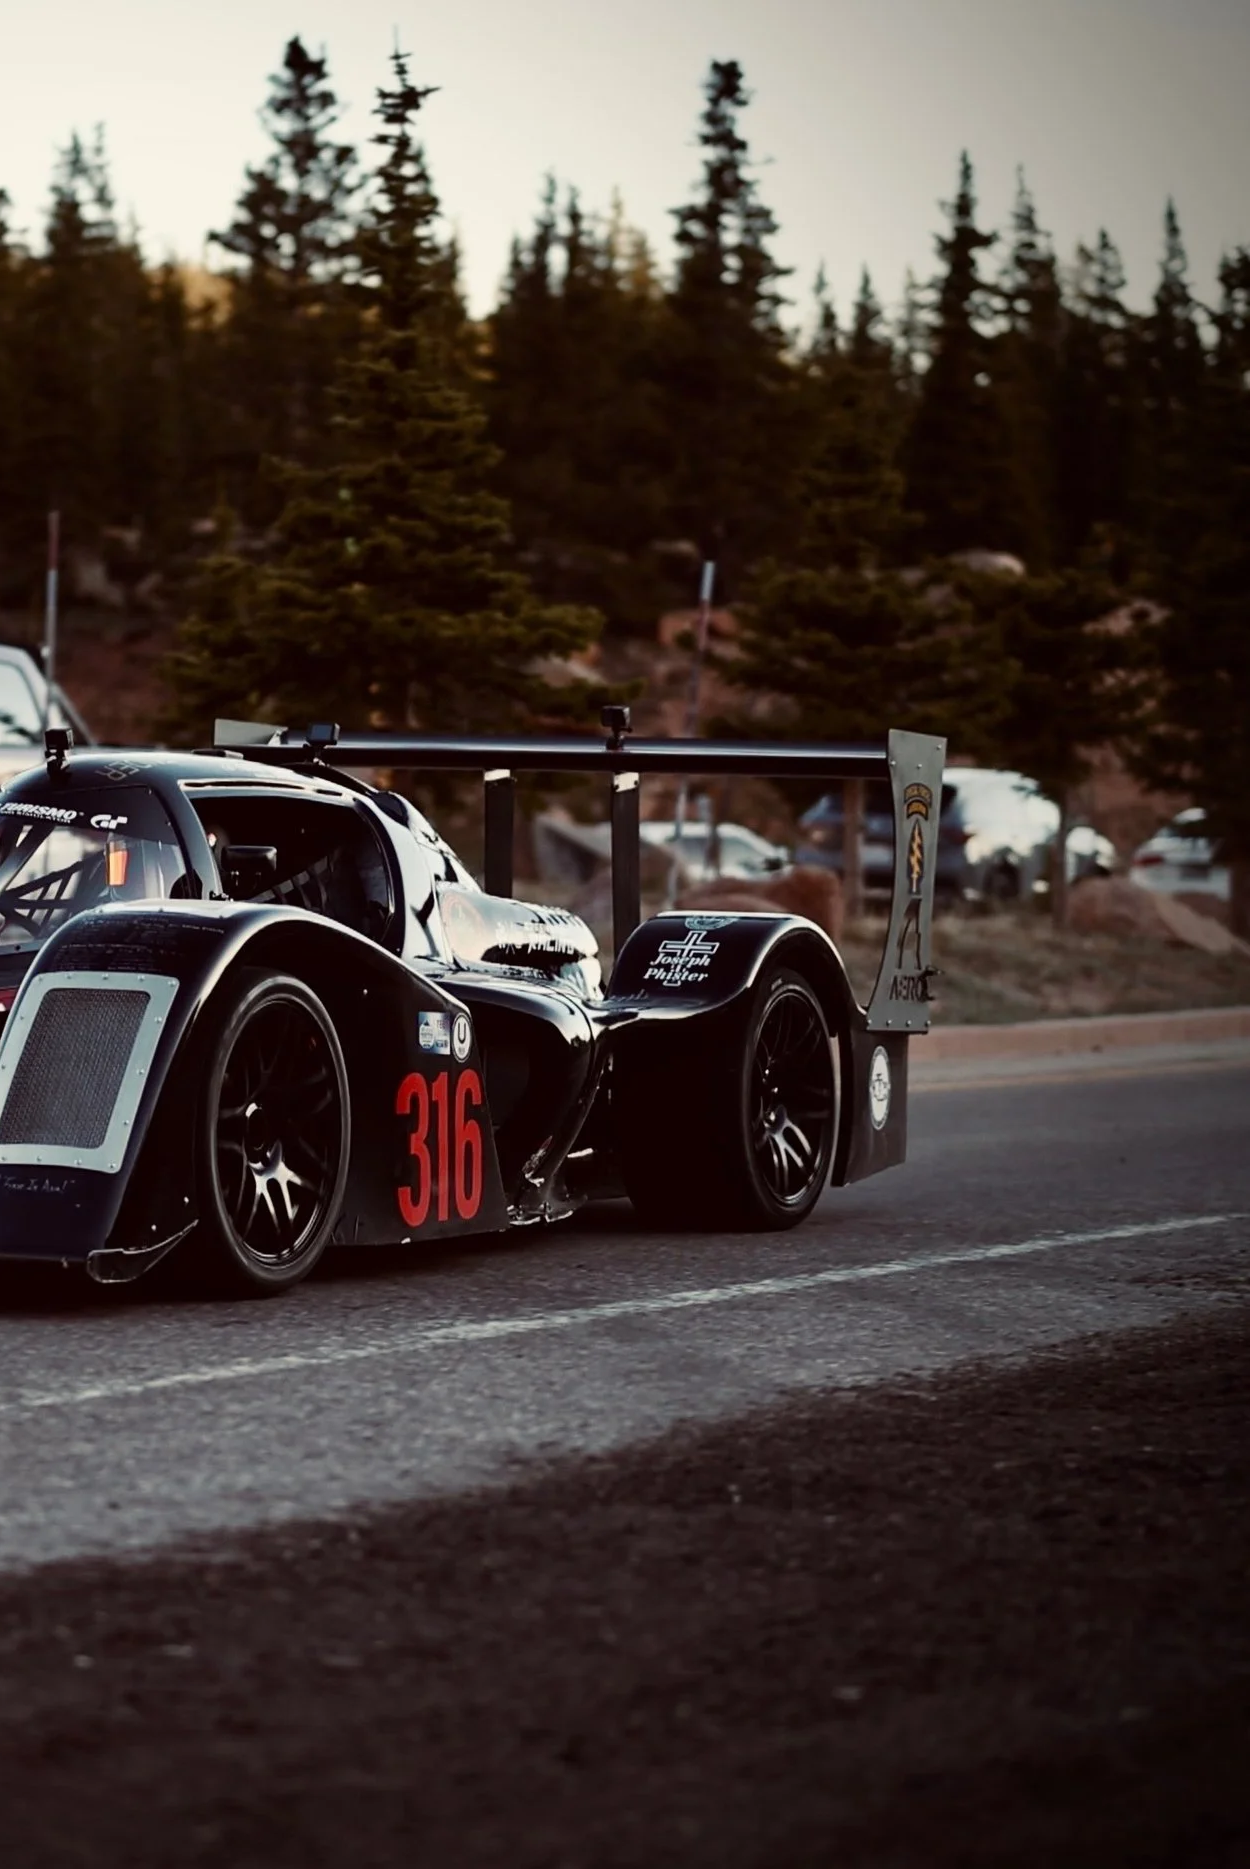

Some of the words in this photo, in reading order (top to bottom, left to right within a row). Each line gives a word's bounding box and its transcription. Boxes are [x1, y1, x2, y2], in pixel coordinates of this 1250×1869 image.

[1, 802, 77, 820] TURISMO
[90, 814, 128, 829] GT
[649, 952, 710, 968] Joseph
[643, 967, 708, 982] Phister
[457, 1022, 467, 1043] U
[396, 1067, 483, 1227] 316
